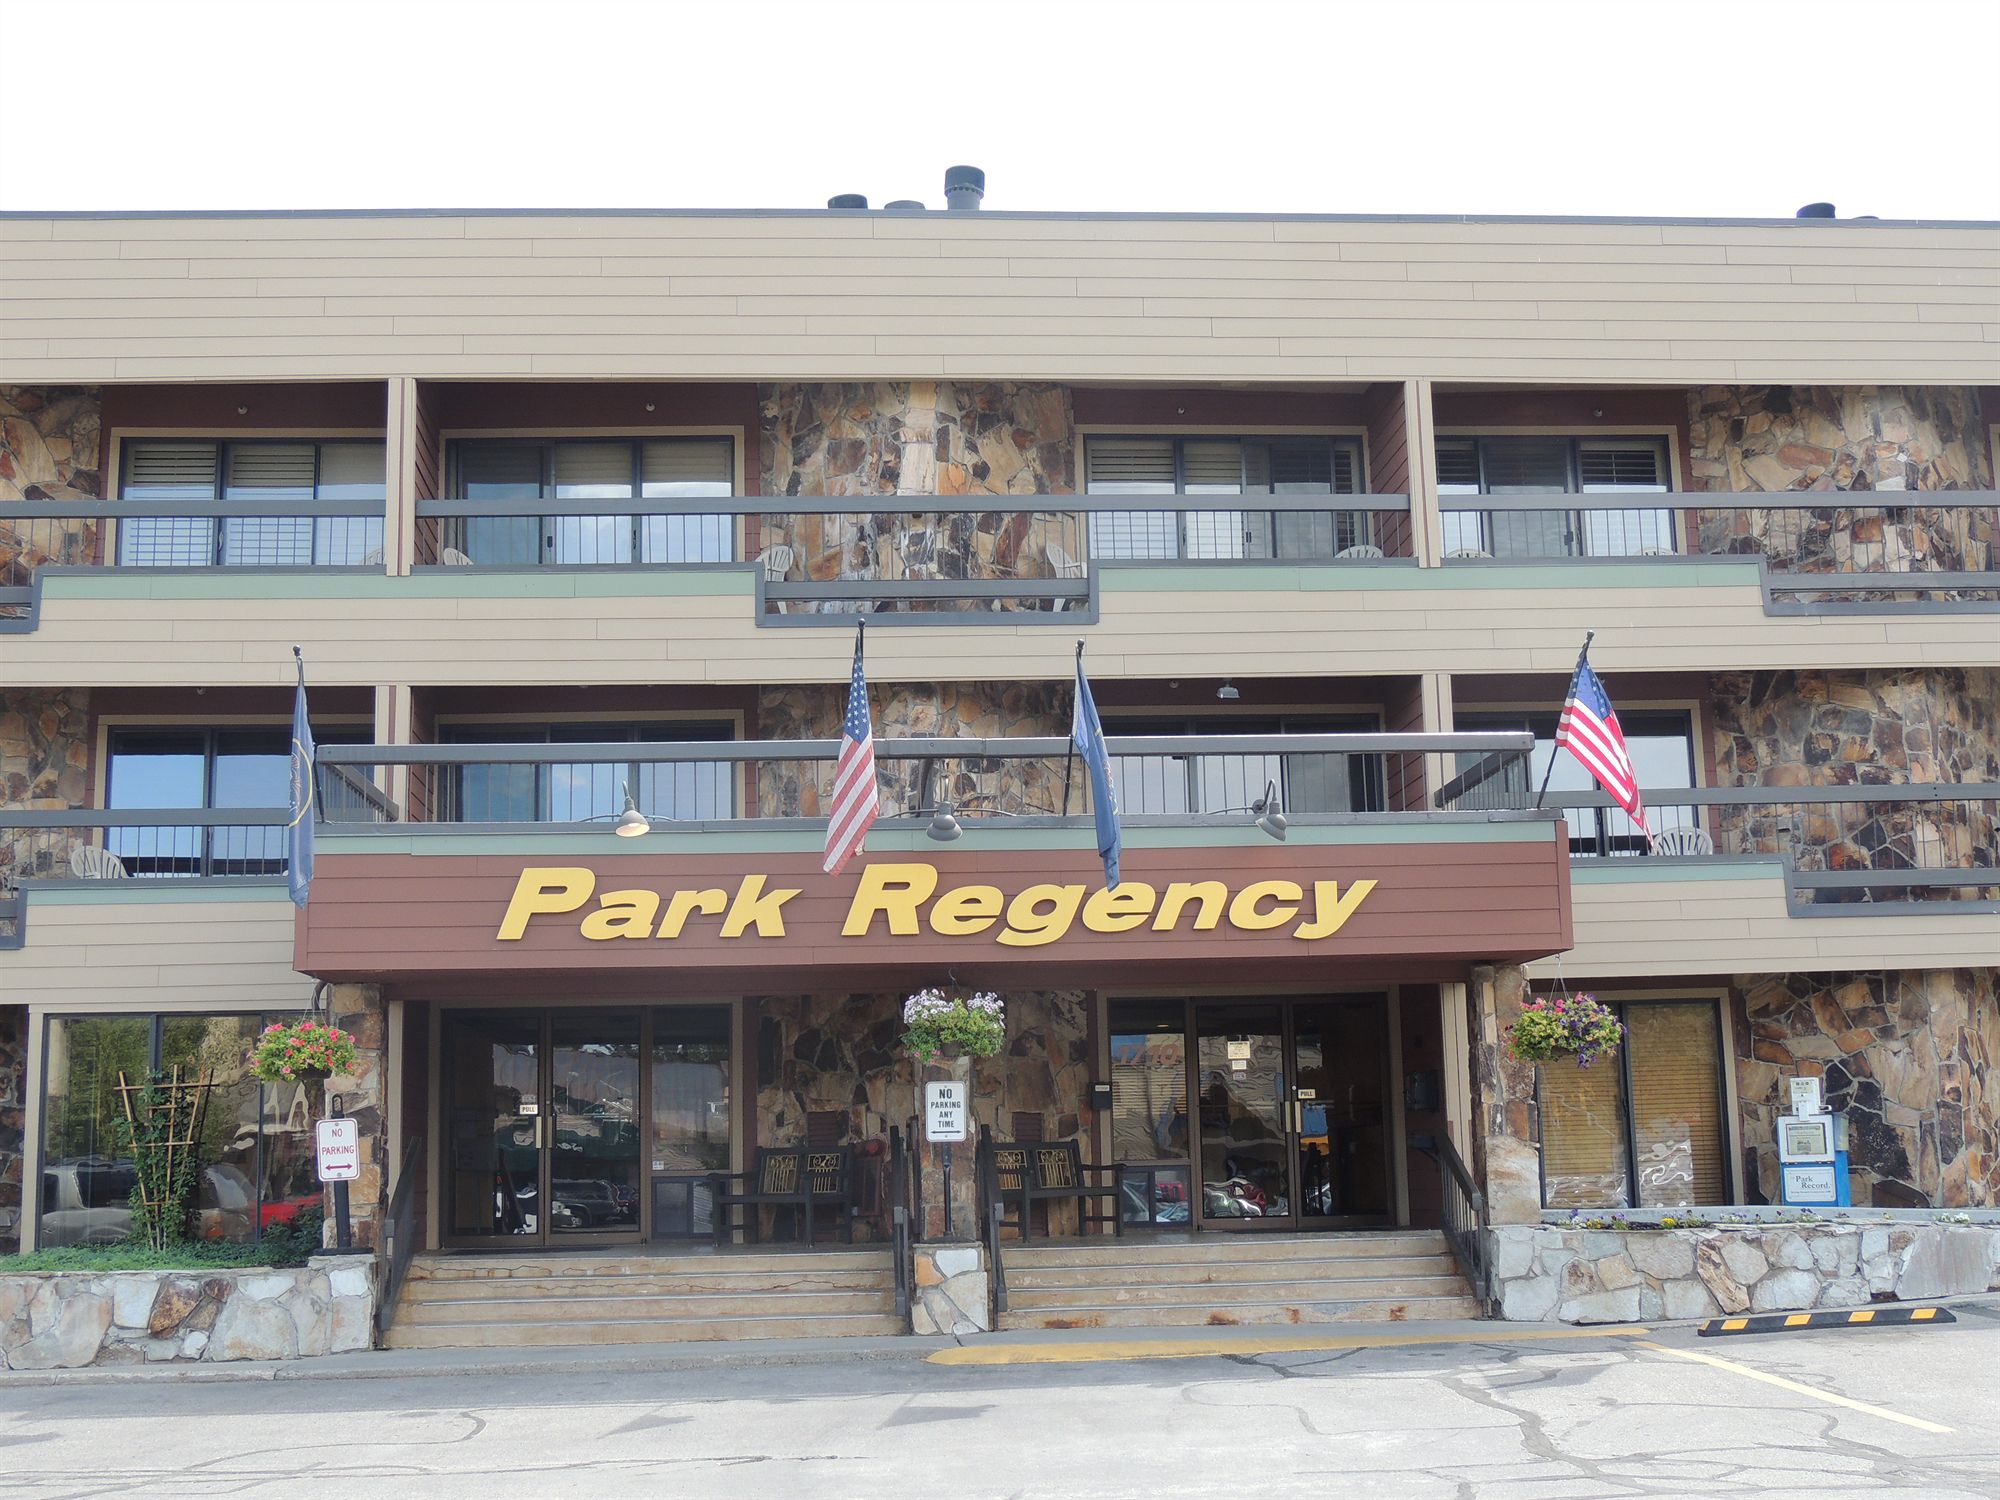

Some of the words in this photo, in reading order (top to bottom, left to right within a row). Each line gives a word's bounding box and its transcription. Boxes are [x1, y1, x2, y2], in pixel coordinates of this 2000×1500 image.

[496, 867, 803, 941] Park
[841, 862, 1379, 947] Regency
[938, 1088, 953, 1099] NO
[930, 1101, 962, 1109] PARKING
[939, 1110, 953, 1119] ANY
[937, 1120, 955, 1128] TIME
[331, 1128, 343, 1138] NO
[321, 1145, 355, 1156] PARKING
